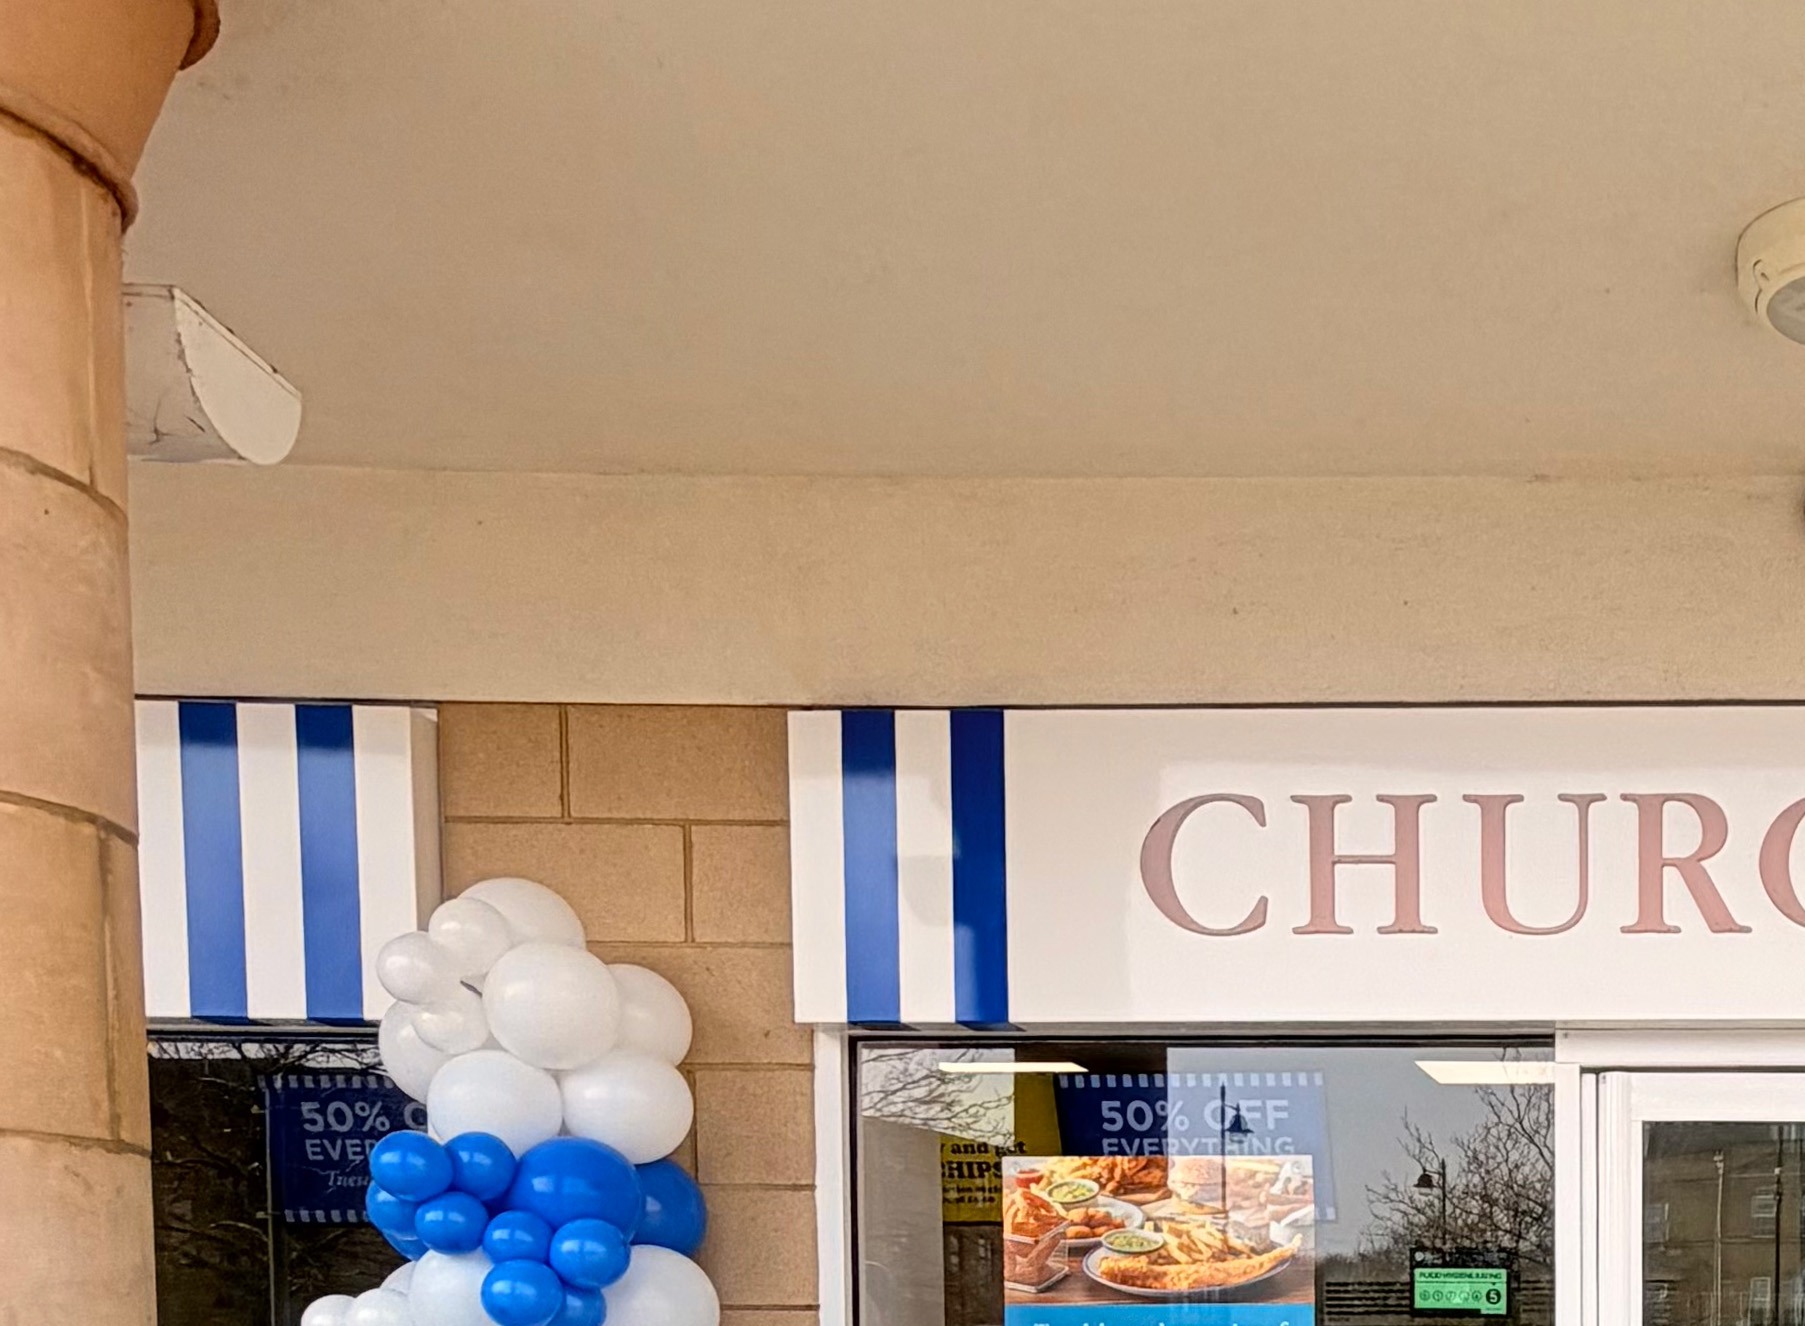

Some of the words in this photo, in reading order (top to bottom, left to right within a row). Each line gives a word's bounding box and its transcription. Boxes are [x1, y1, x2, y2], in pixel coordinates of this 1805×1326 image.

[300, 1101, 390, 1132] 50%
[1101, 1099, 1190, 1132] 50%
[1204, 1099, 1289, 1131] OFF
[950, 1142, 988, 1154] and
[1102, 1136, 1295, 1156] EVERYTHING
[941, 1161, 1003, 1179] HIPS
